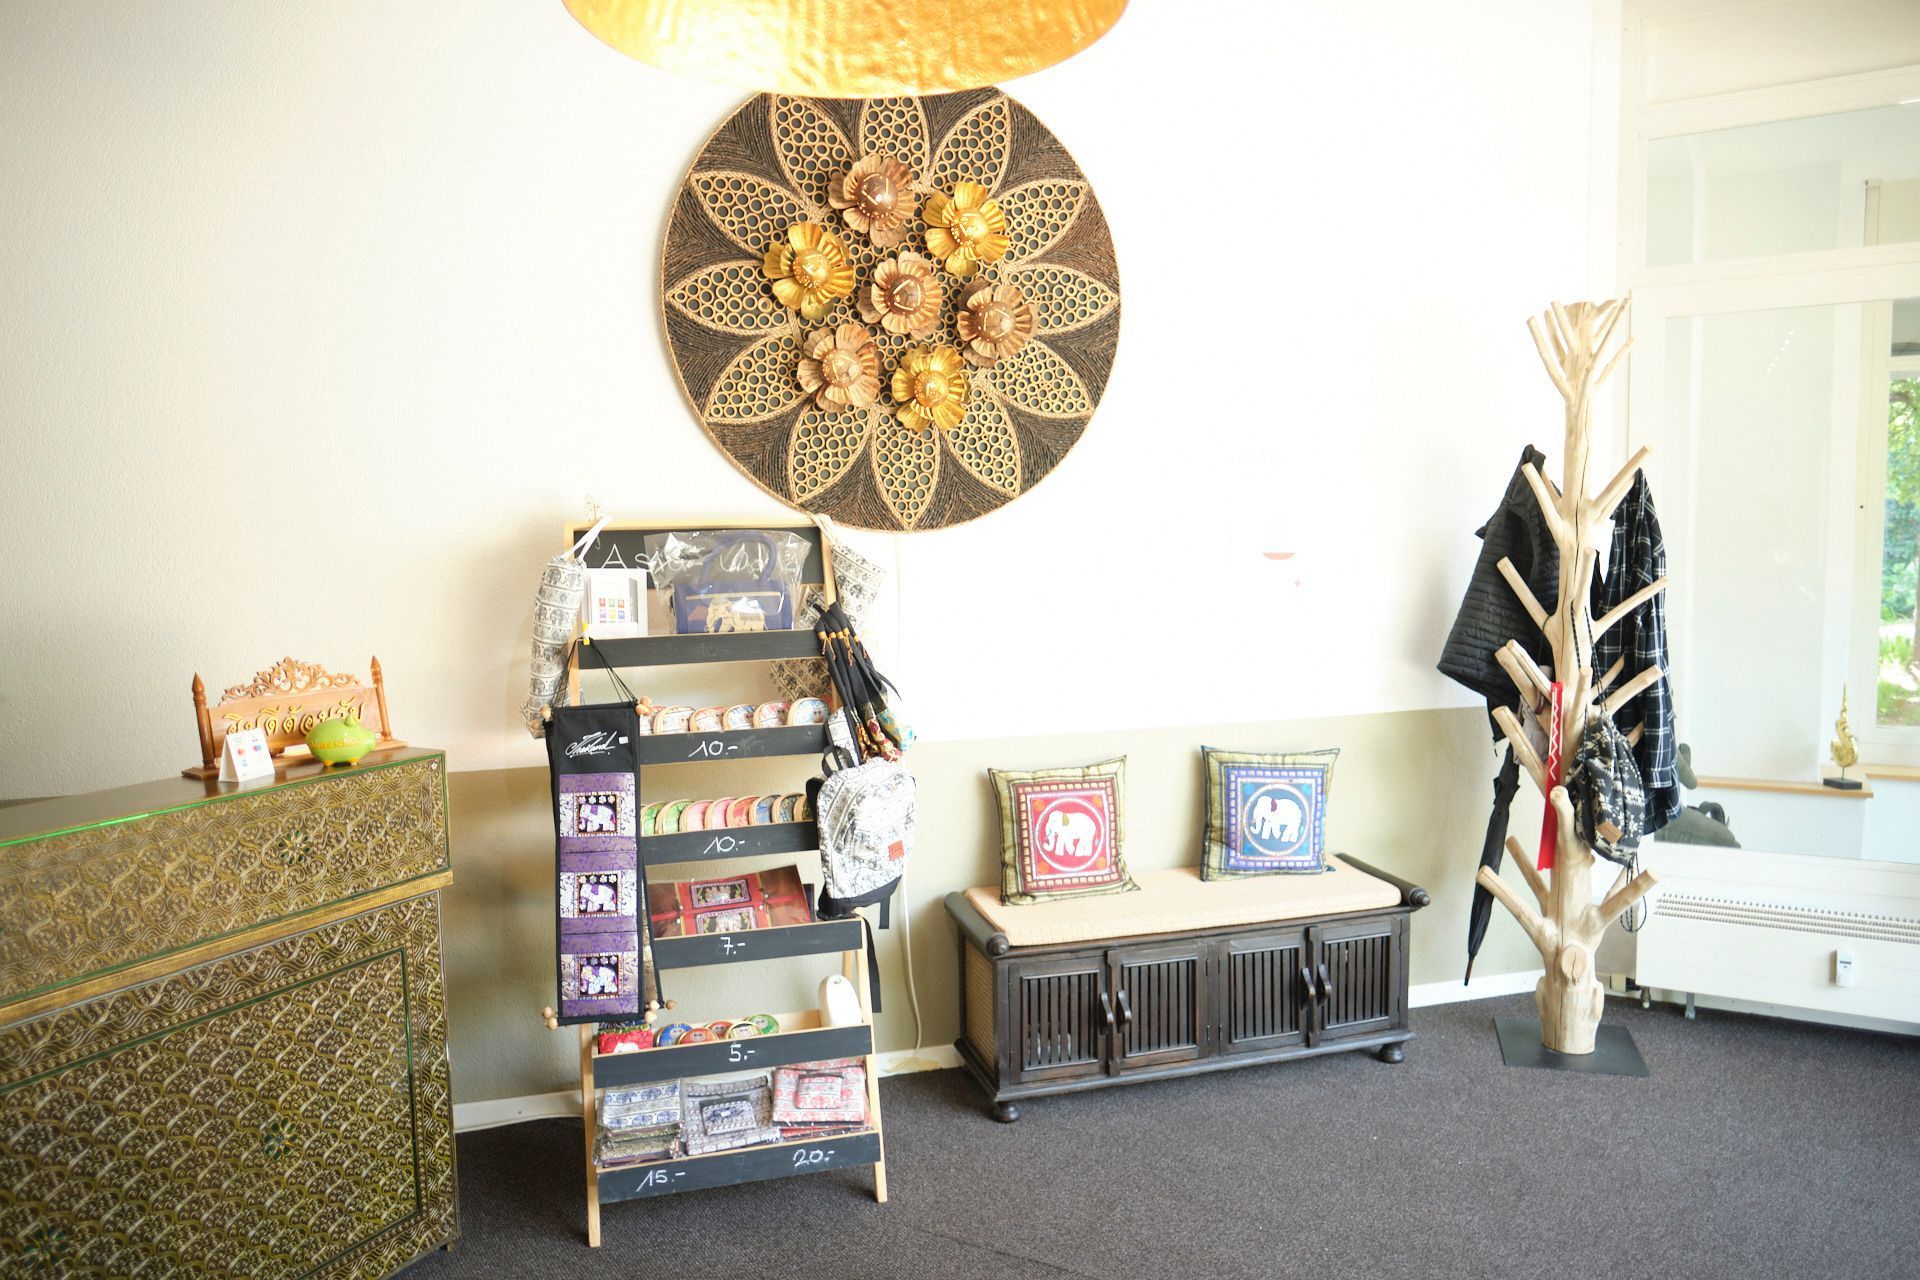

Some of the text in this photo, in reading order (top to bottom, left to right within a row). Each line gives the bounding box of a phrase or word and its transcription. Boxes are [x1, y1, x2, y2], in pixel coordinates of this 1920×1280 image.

[688, 740, 738, 757] 10.-
[703, 836, 746, 854] 10.-
[720, 936, 745, 956] 7.-
[728, 1043, 755, 1062] 5.-
[793, 1149, 835, 1167] 20.-
[636, 1169, 686, 1192] 15.-
